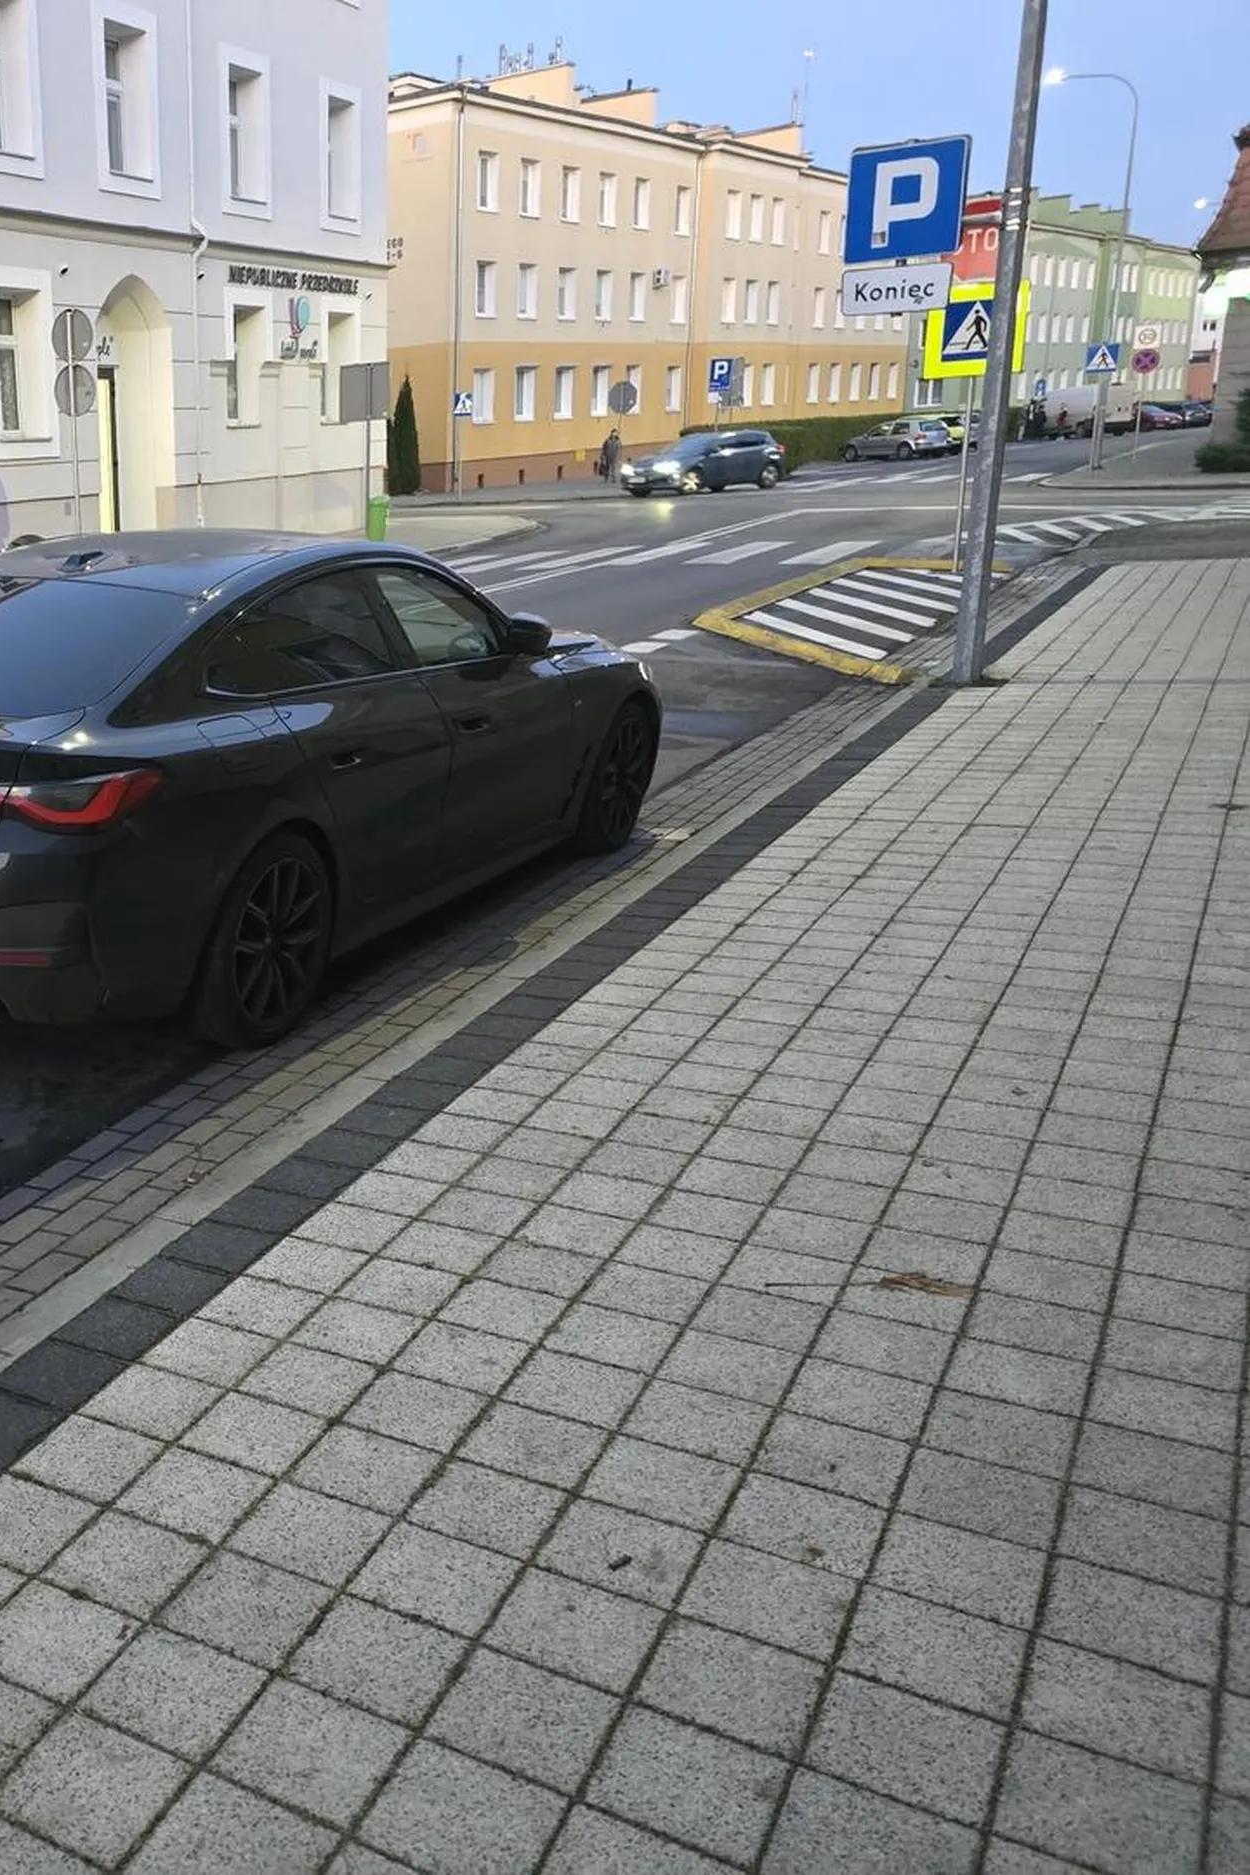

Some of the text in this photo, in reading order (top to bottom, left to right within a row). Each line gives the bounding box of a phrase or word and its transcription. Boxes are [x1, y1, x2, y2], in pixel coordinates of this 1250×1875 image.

[871, 156, 940, 249] P
[855, 278, 935, 303] Koniec
[713, 361, 728, 380] P
